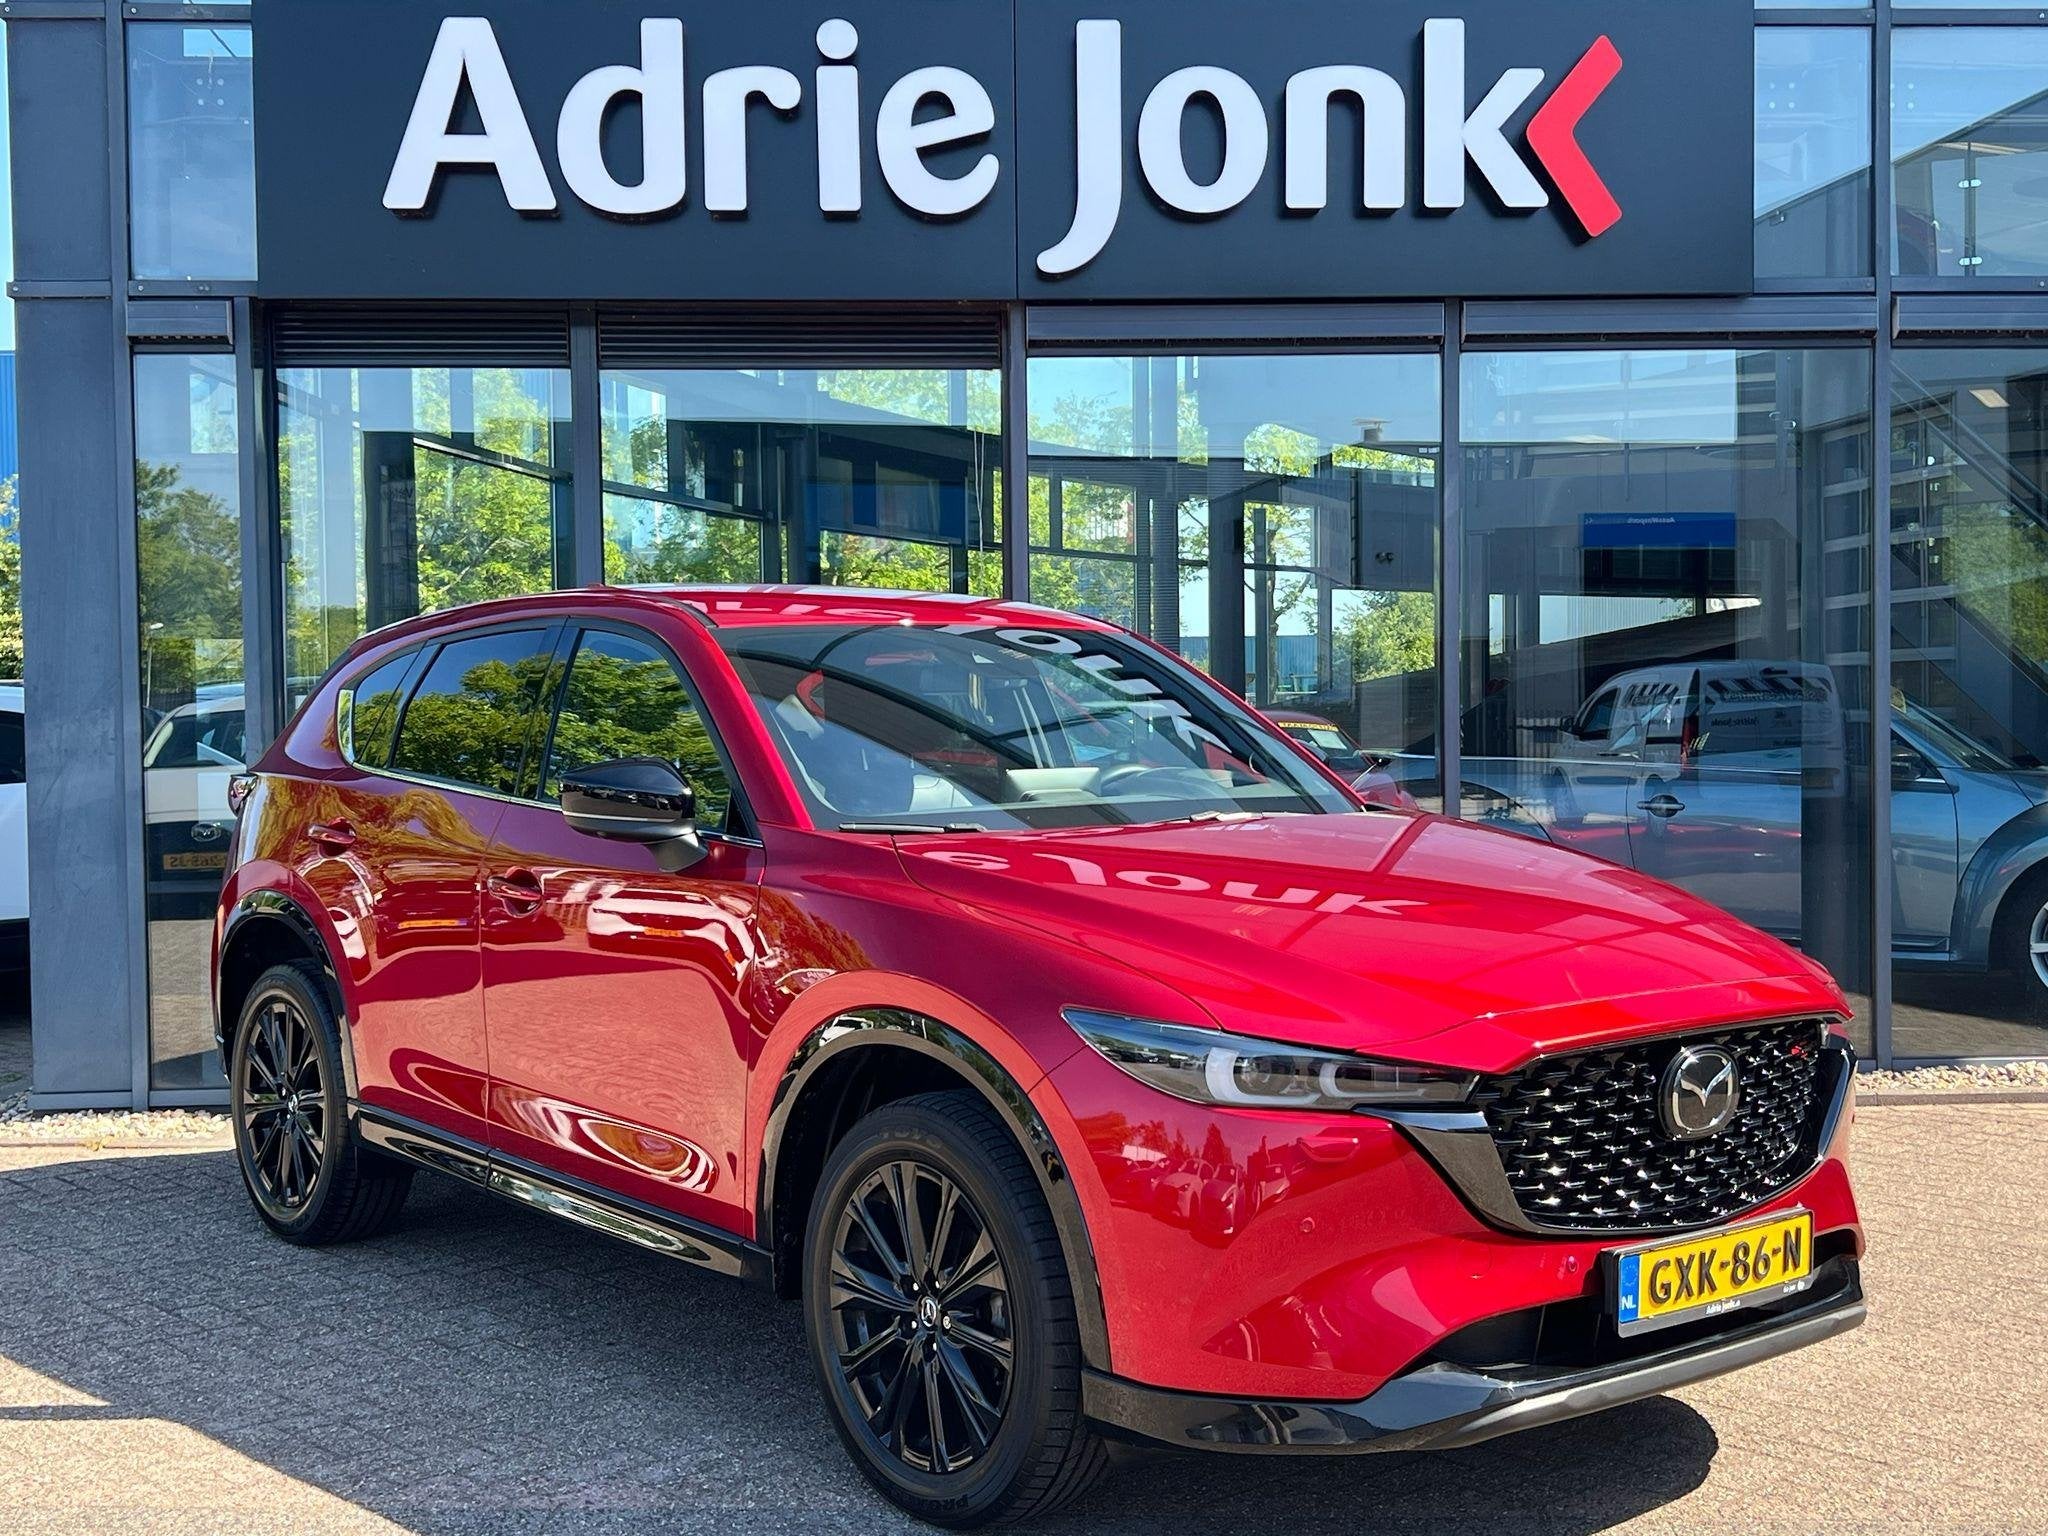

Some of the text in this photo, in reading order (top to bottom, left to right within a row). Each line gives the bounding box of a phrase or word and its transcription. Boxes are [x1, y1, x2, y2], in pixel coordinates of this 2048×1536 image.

[381, 15, 1550, 274] Adrie Jonk
[1621, 1295, 1637, 1310] NL
[1650, 1226, 1802, 1305] GXK-86-N
